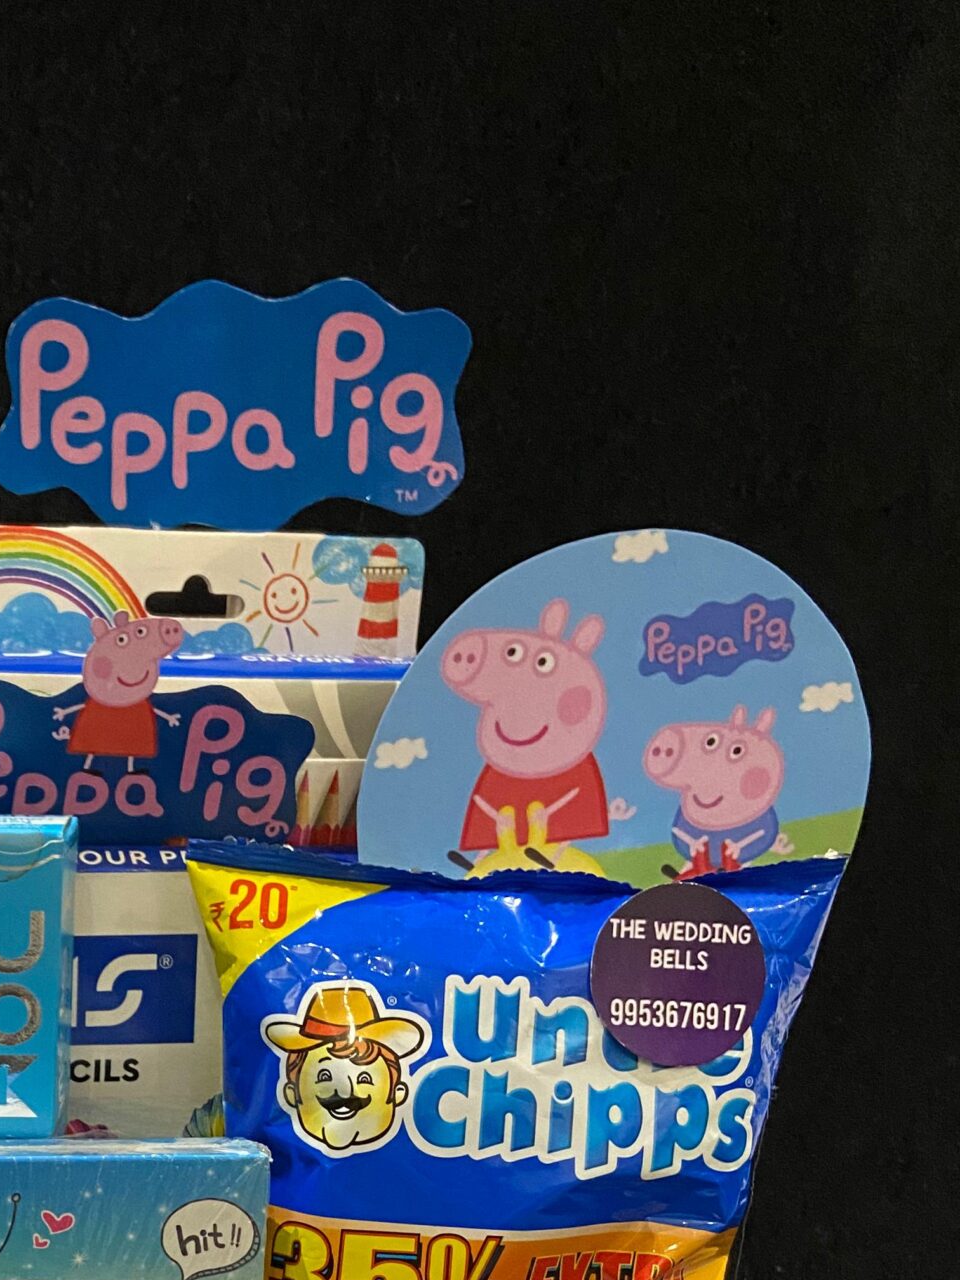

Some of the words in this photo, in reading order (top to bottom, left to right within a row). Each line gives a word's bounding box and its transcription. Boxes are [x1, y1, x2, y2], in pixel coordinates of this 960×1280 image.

[19, 319, 295, 510] Peppa
[314, 311, 458, 488] Pig
[646, 620, 739, 676] Peppa
[743, 602, 792, 653] Pig
[179, 704, 289, 838] Pig
[78, 849, 149, 866] OUR
[609, 917, 647, 940] THE
[653, 920, 753, 945] WEDDING
[649, 948, 710, 971] BELLS
[609, 997, 747, 1031] 9953676917
[69, 1058, 140, 1083] CILS
[410, 1062, 756, 1175] Chipps
